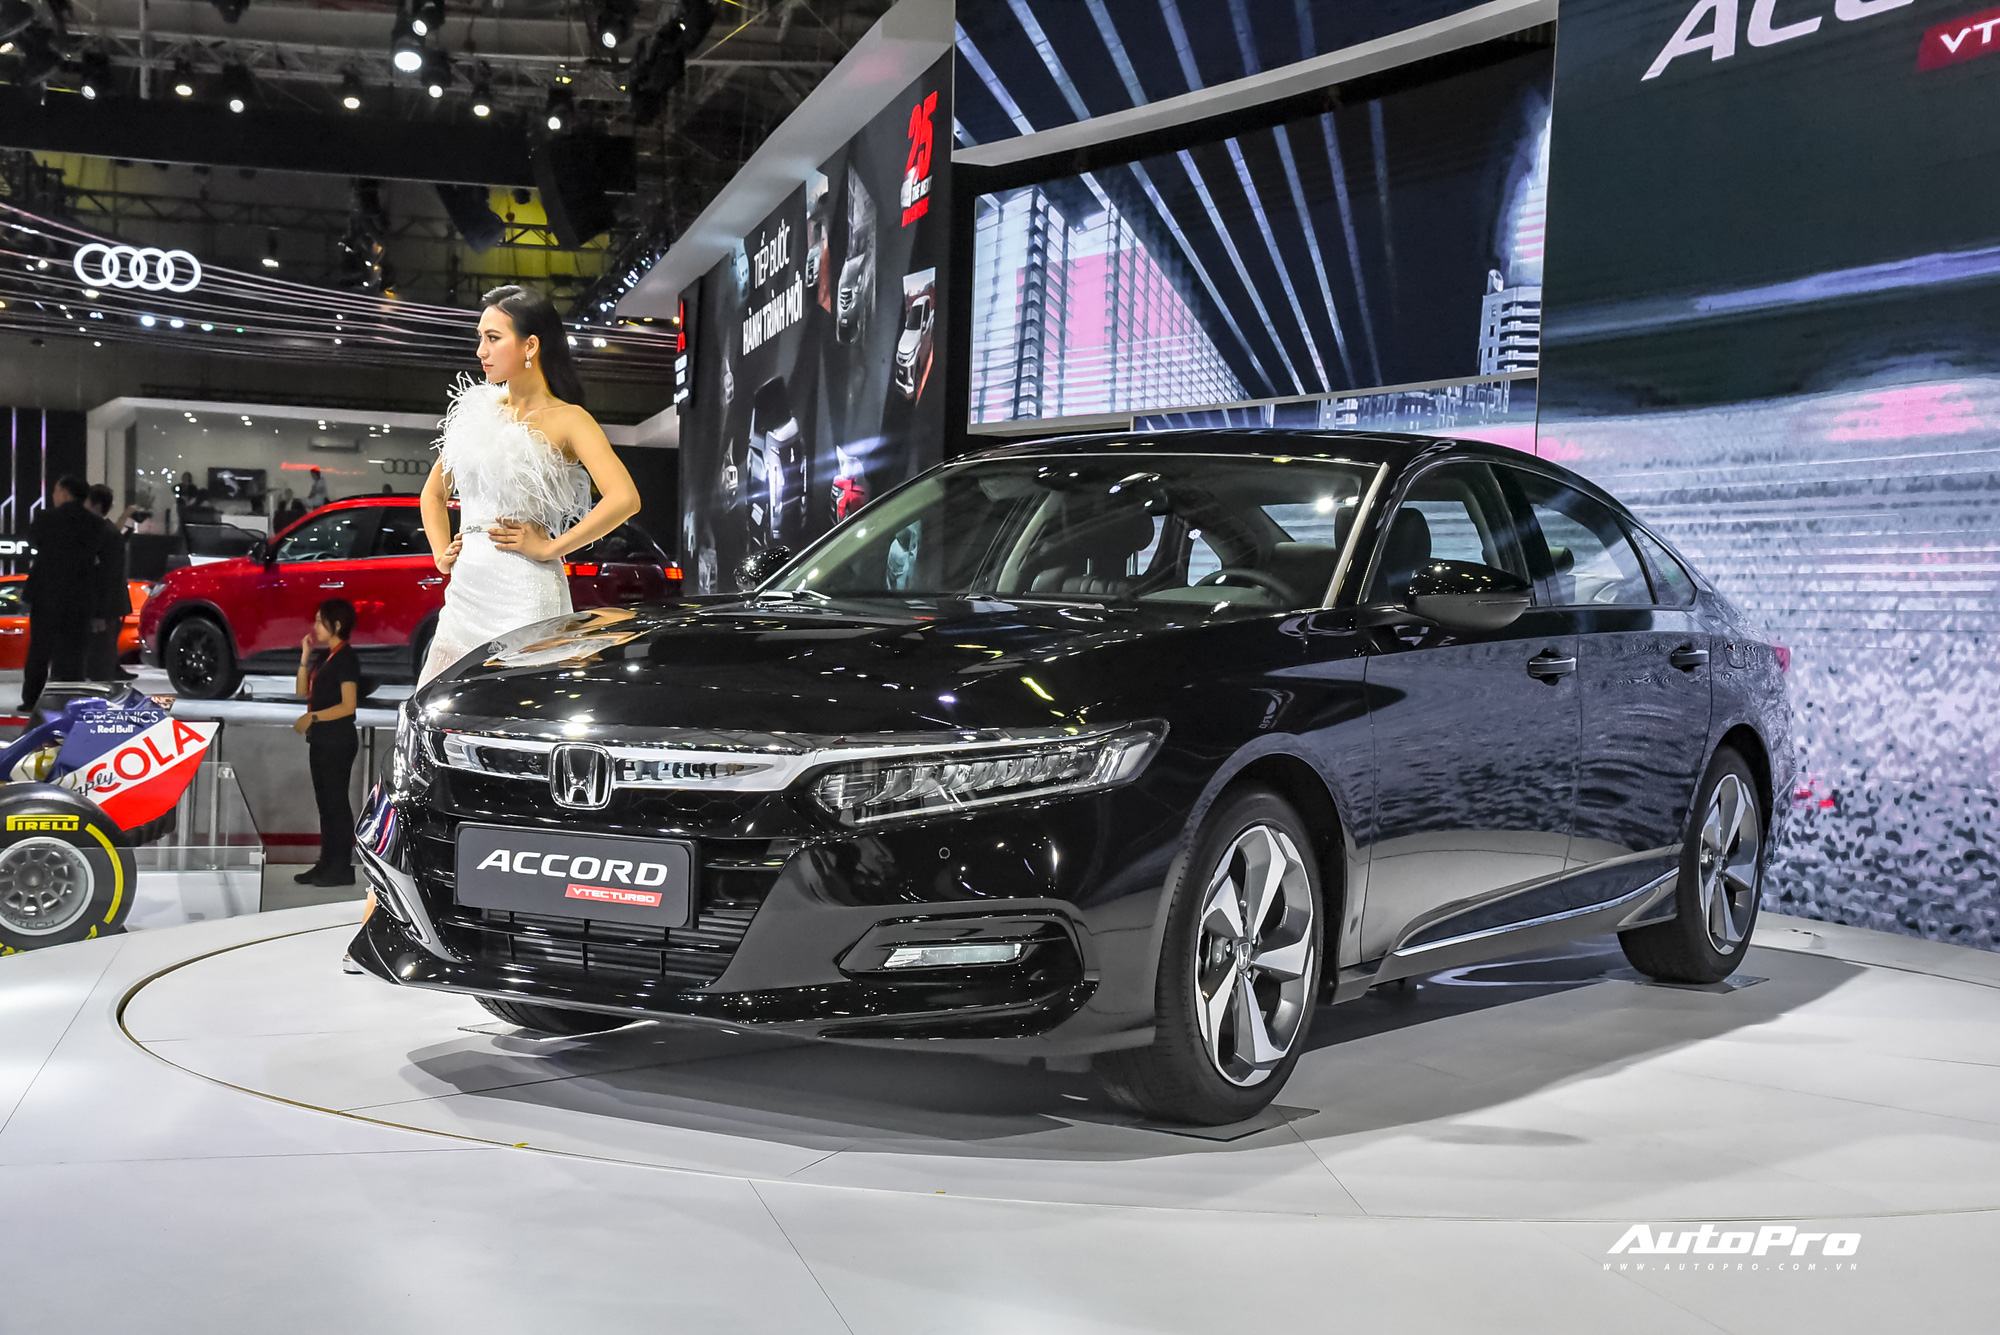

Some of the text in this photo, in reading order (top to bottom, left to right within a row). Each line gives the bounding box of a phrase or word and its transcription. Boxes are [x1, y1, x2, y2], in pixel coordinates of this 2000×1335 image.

[904, 90, 938, 181] 25
[83, 710, 159, 724] ORGANICS
[97, 724, 116, 734] Red
[116, 724, 133, 734] Bull
[86, 719, 207, 793] COLA
[6, 814, 80, 832] PIRELLI
[476, 849, 668, 887] ACCORD
